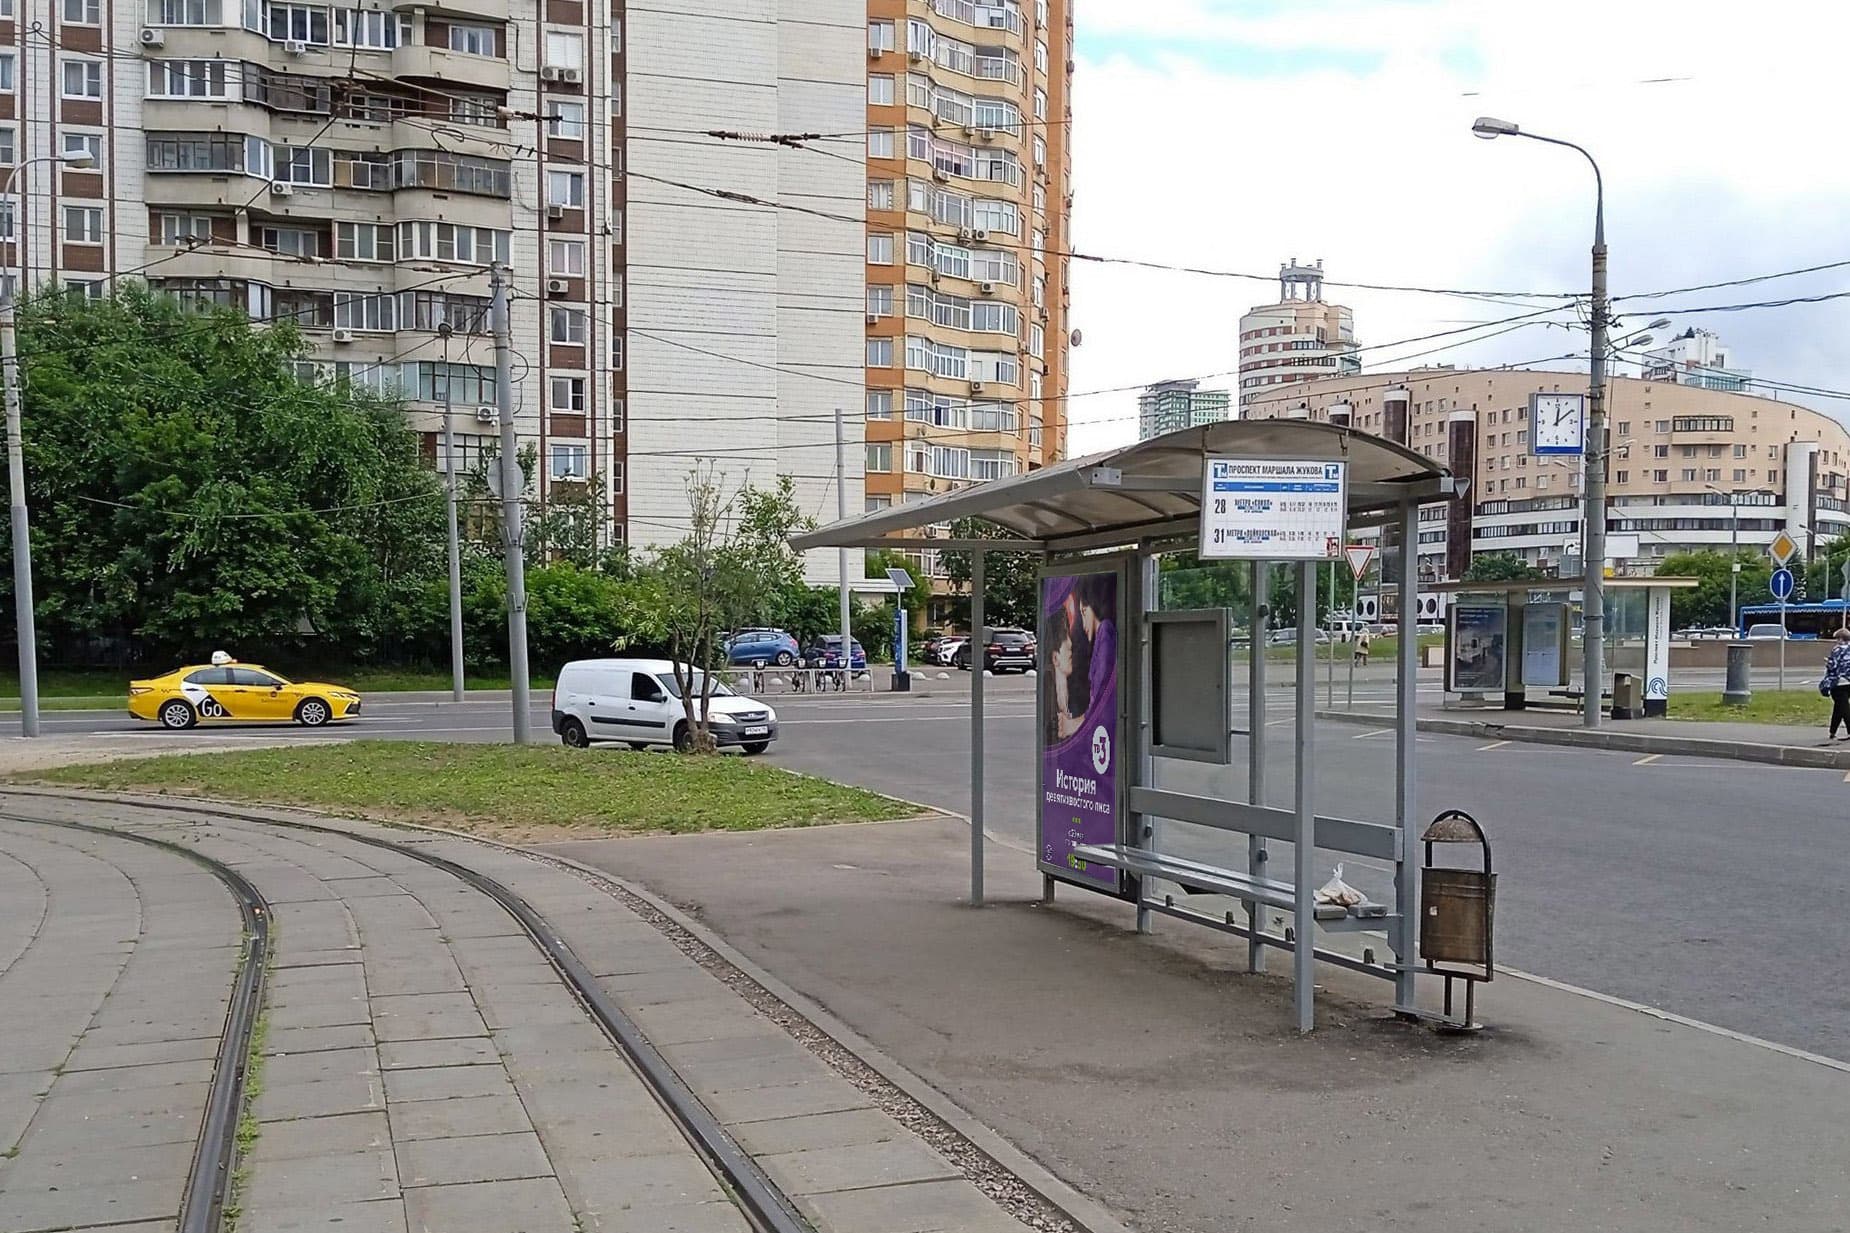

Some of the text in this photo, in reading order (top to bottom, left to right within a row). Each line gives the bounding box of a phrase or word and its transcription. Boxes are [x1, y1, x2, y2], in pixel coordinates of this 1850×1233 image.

[1228, 465, 1261, 475] ПРОСПЕКТ
[1262, 465, 1295, 475] МАРШАЛА
[1295, 466, 1323, 475] ЖУКОВА
[1214, 499, 1226, 514] 28
[1214, 528, 1225, 544] 31
[202, 698, 222, 717] Go
[1056, 768, 1096, 797] История
[1046, 791, 1110, 814] девятихвостого лиса
